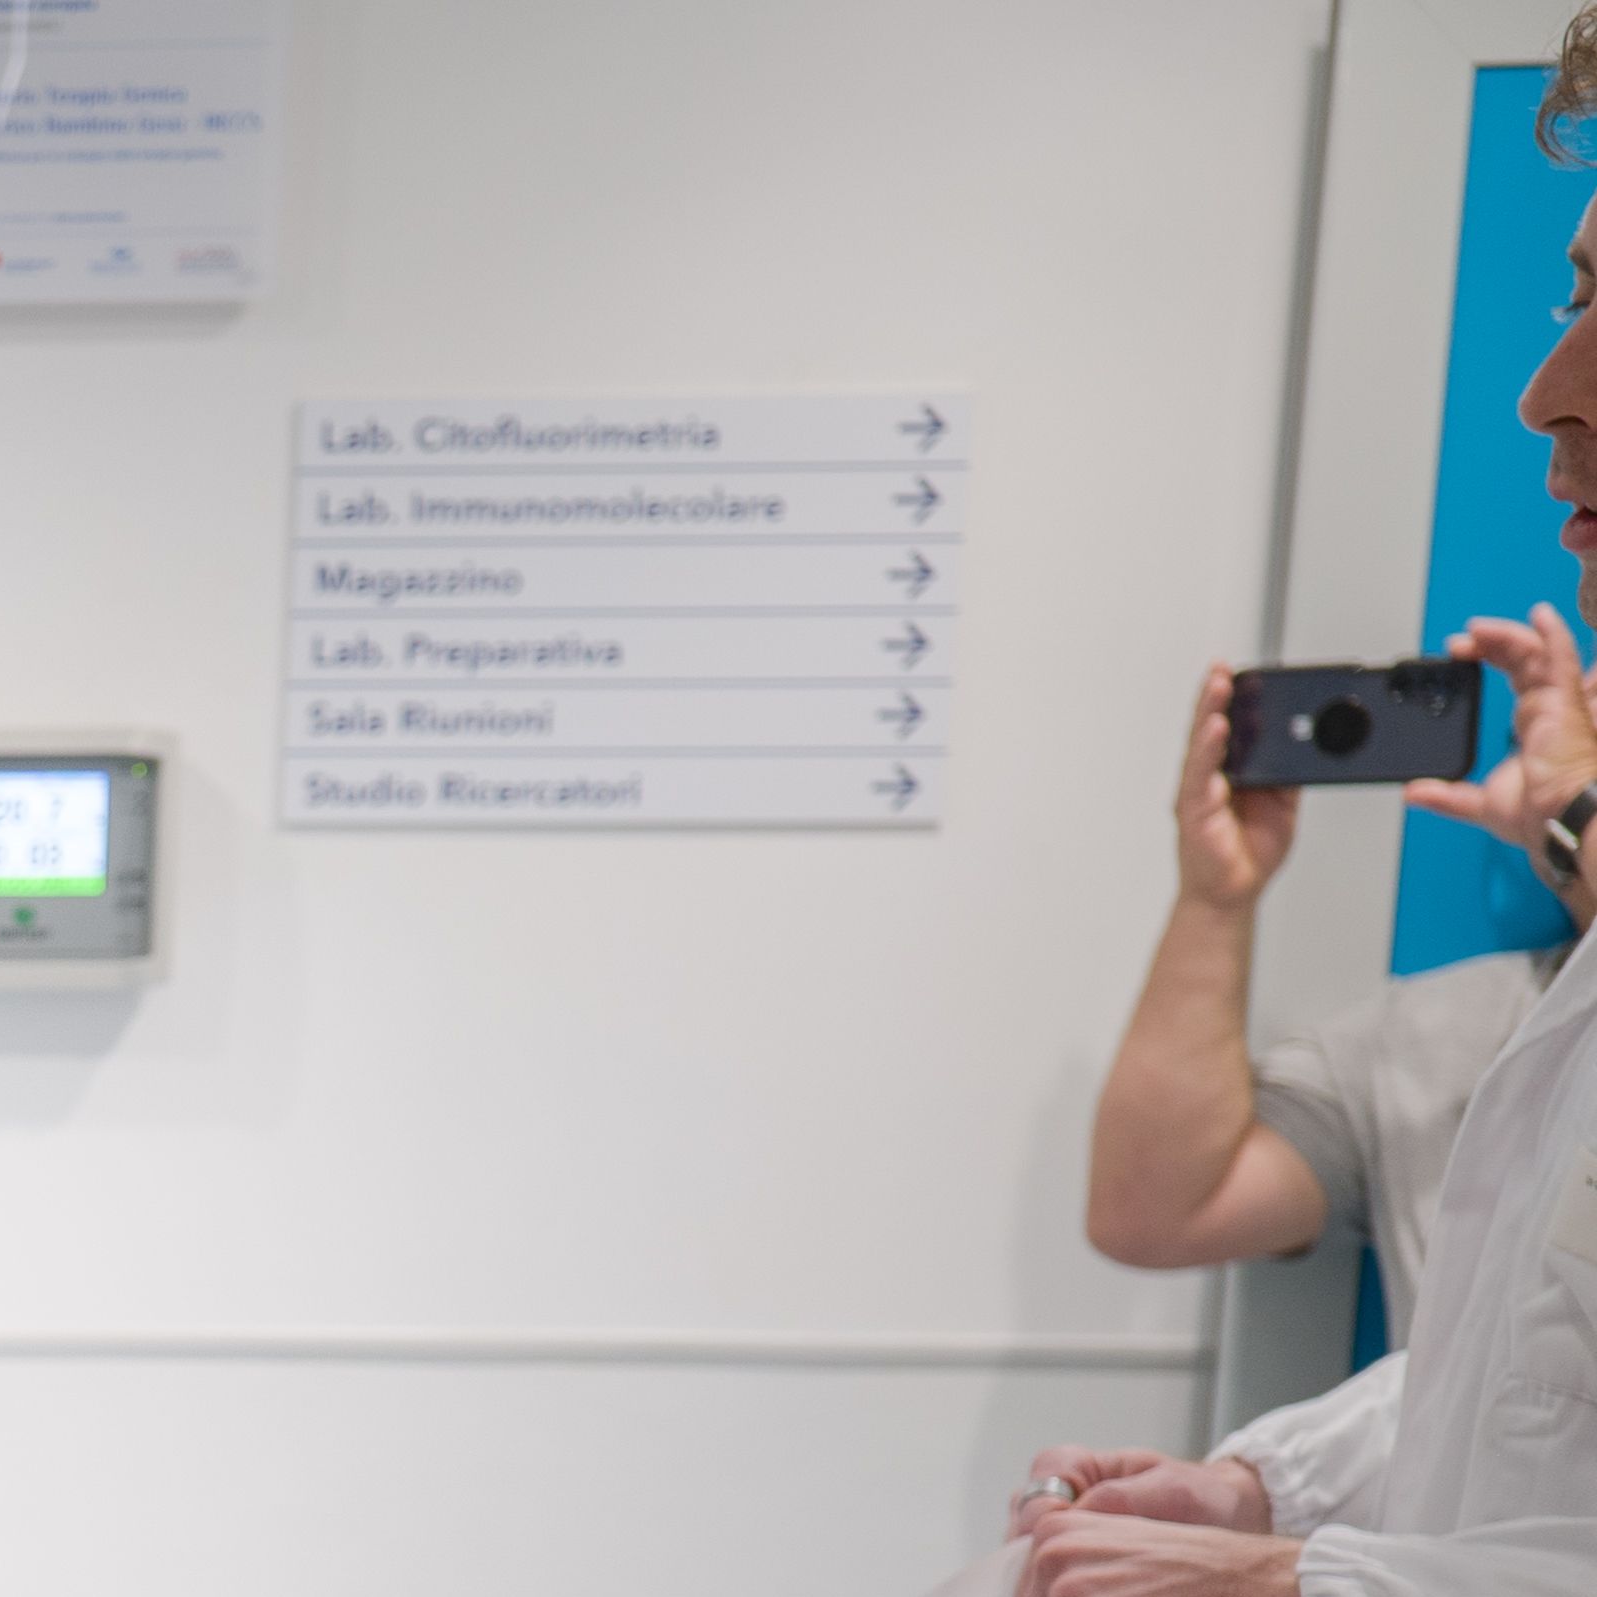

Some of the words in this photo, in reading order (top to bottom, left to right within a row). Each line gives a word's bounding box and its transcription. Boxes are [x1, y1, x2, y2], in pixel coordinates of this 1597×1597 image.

[319, 419, 401, 456] Lab.
[412, 416, 722, 455] Citofluorimetria
[316, 490, 397, 527] Lab.
[409, 486, 788, 525] Immunomolecolare
[312, 560, 524, 605] Magazzino
[310, 633, 392, 670] Lab.
[402, 631, 624, 673] Preparativa
[306, 700, 387, 738] Sala
[397, 700, 555, 736] Riunioni
[302, 770, 425, 809] Studio
[436, 770, 645, 808] Ricercatori
